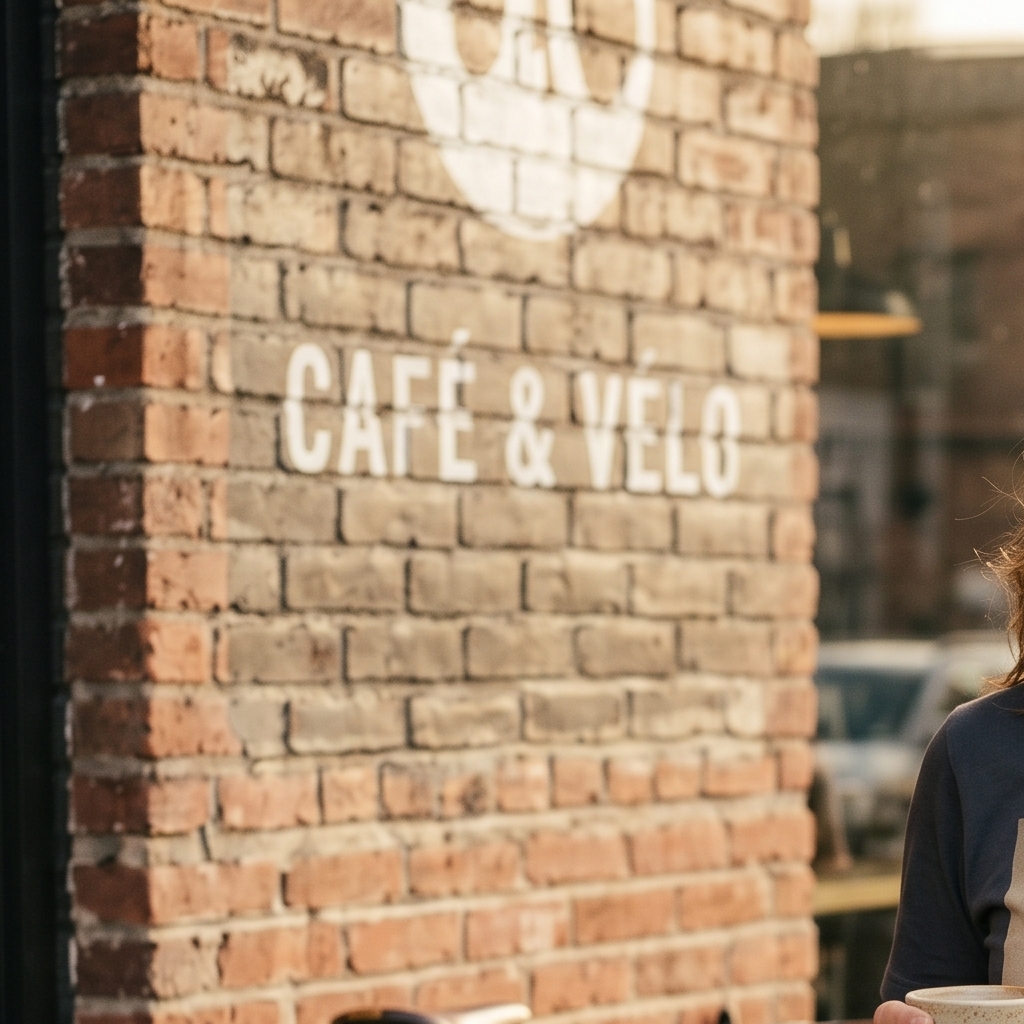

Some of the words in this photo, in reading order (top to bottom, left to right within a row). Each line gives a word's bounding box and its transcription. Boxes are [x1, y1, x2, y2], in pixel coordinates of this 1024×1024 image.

[284, 329, 478, 483] CAFÉ
[506, 367, 557, 488] &
[580, 350, 740, 497] VÉLO
